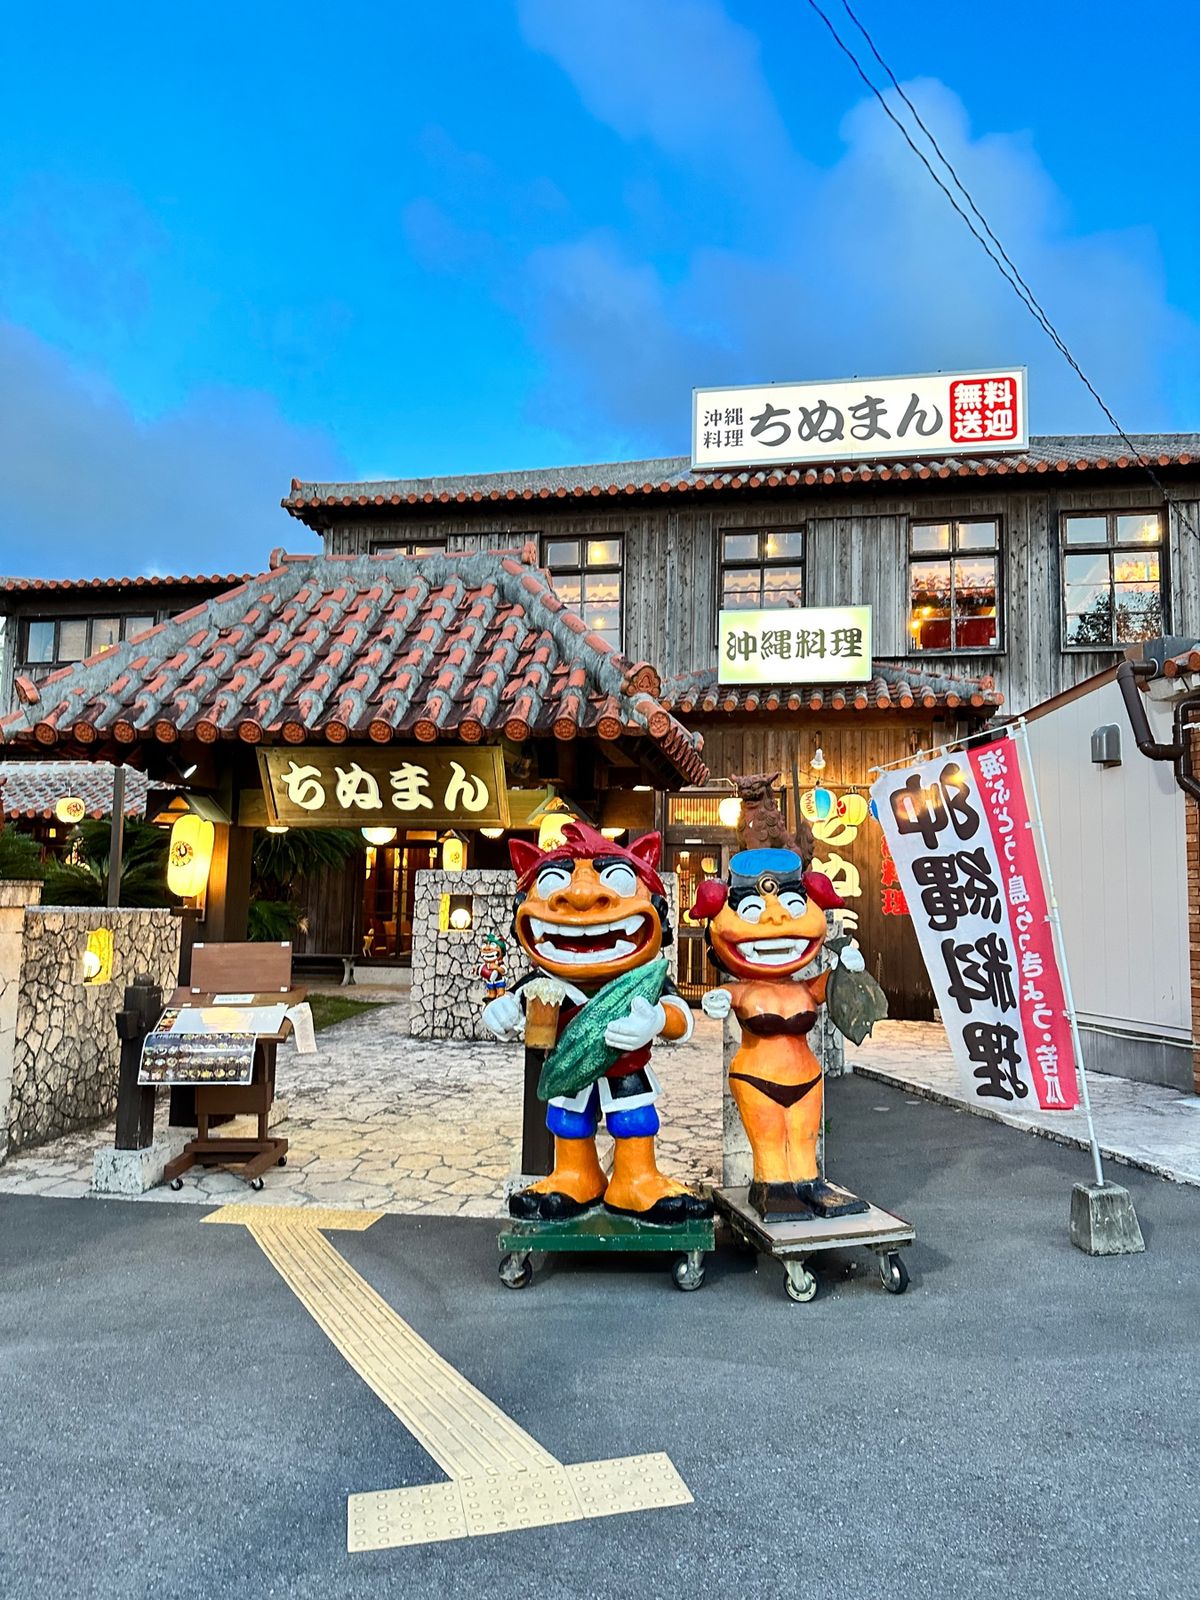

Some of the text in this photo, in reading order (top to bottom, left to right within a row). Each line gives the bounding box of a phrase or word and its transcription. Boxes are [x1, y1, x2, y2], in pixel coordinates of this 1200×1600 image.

[953, 380, 1014, 410] 無料
[704, 408, 743, 427] 沖縄
[750, 393, 944, 447] ちぬまん
[953, 409, 1014, 440] 送迎
[704, 429, 743, 449] 料理
[726, 627, 863, 662] 沖縄料理
[281, 760, 489, 812] ちぬまん
